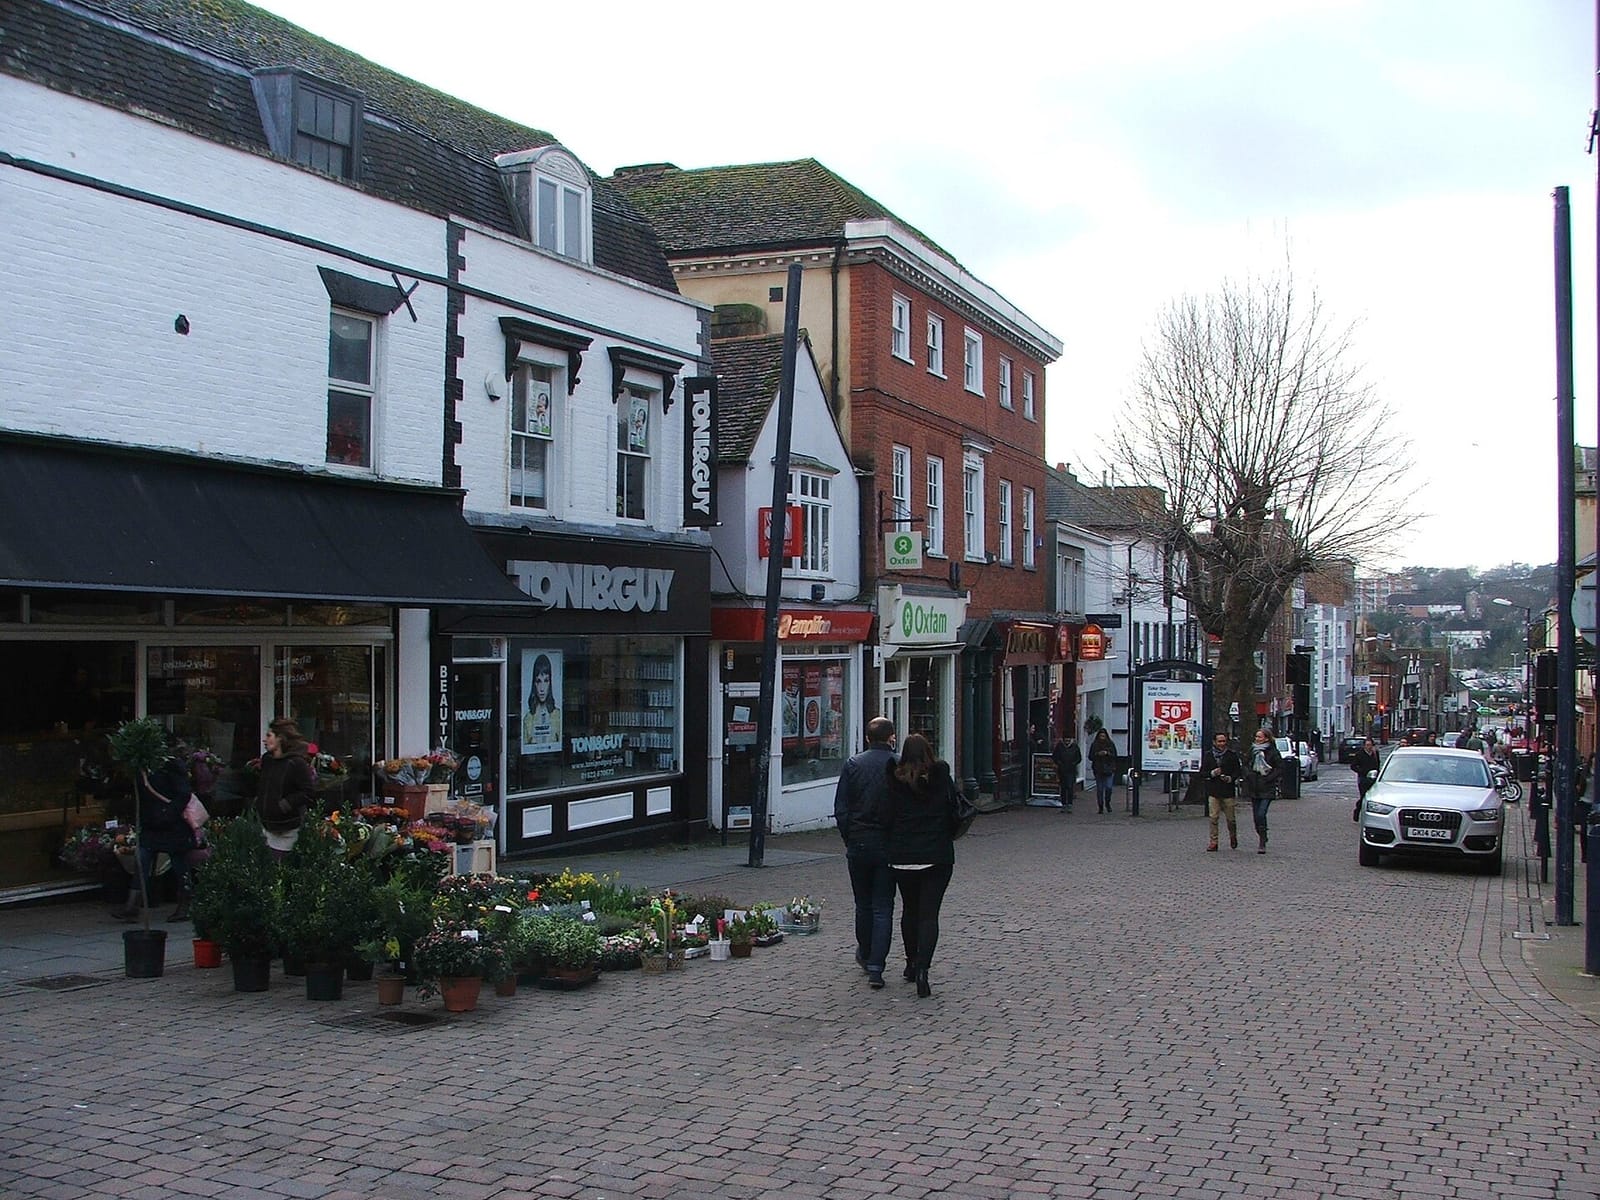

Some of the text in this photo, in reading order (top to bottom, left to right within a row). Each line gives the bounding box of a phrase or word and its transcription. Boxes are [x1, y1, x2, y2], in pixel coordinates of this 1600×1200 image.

[692, 389, 711, 515] TONI&GUY
[889, 556, 918, 566] Oxfam
[508, 560, 675, 612] TONI&GUY
[790, 615, 832, 638] amplifon
[915, 605, 948, 633] Oxfam
[439, 665, 449, 749] BEAUTY
[454, 709, 492, 721] TONI&GUY
[571, 734, 623, 753] TONI&GUY
